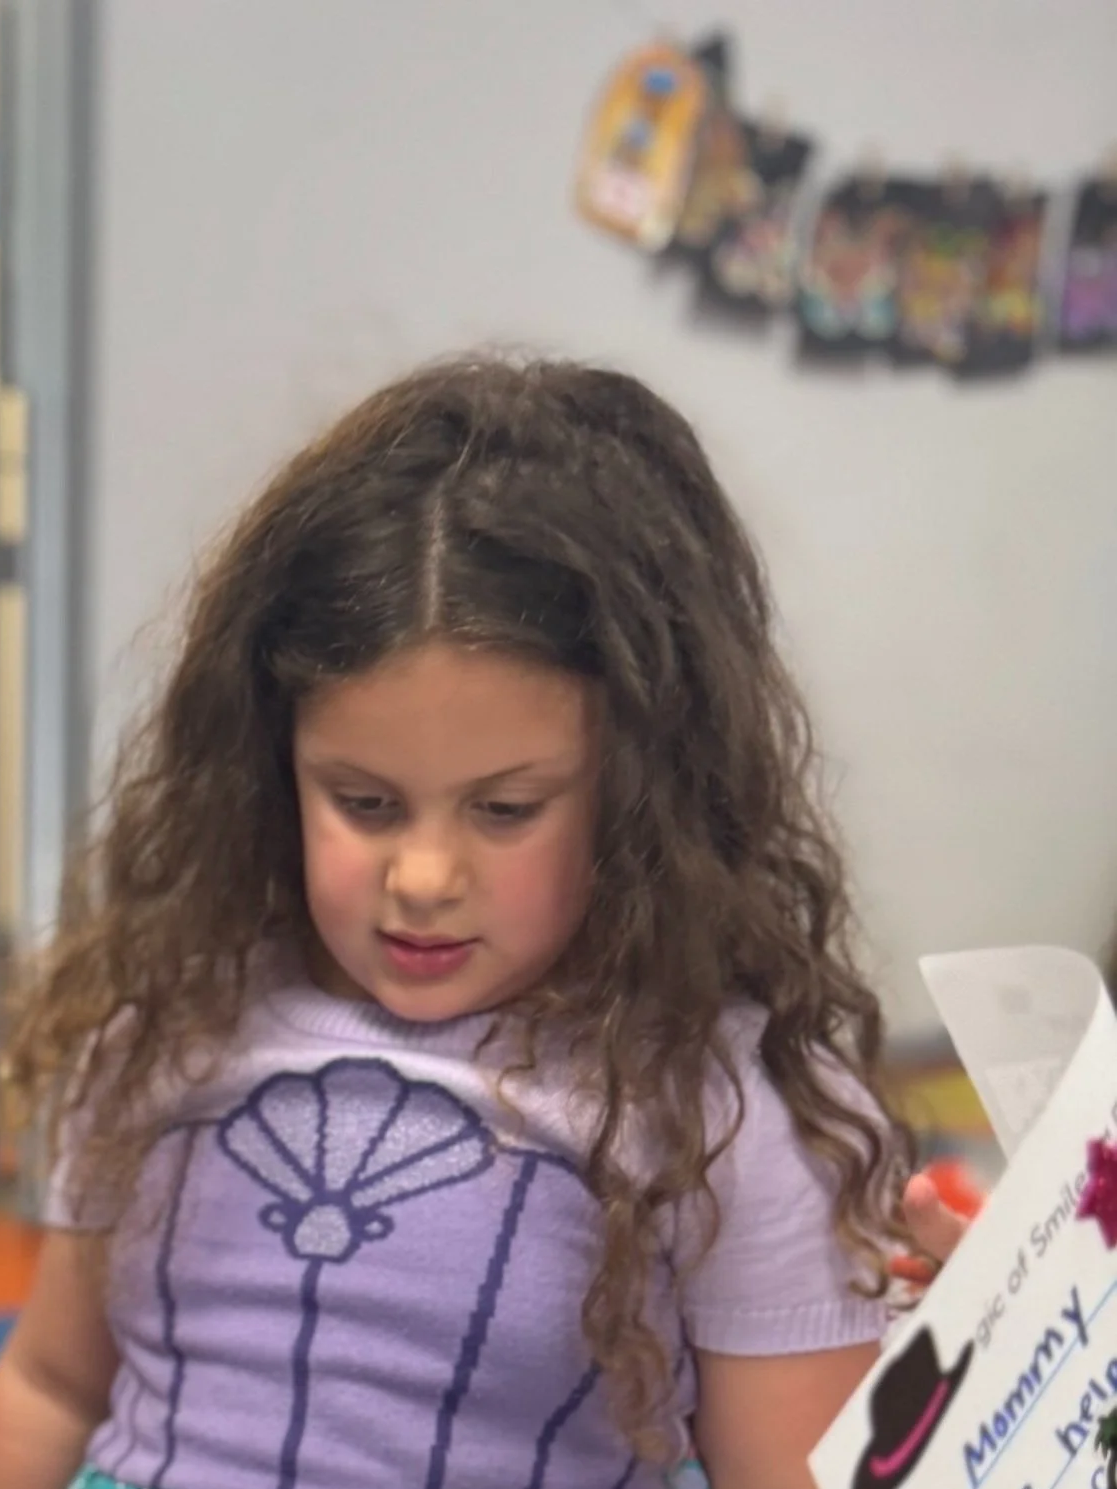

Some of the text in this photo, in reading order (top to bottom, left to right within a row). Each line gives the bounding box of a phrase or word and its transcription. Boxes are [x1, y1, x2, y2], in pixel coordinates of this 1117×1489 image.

[1008, 1246, 1029, 1295] of
[1030, 1171, 1086, 1257] Smile
[963, 1284, 1089, 1489] Mommy
